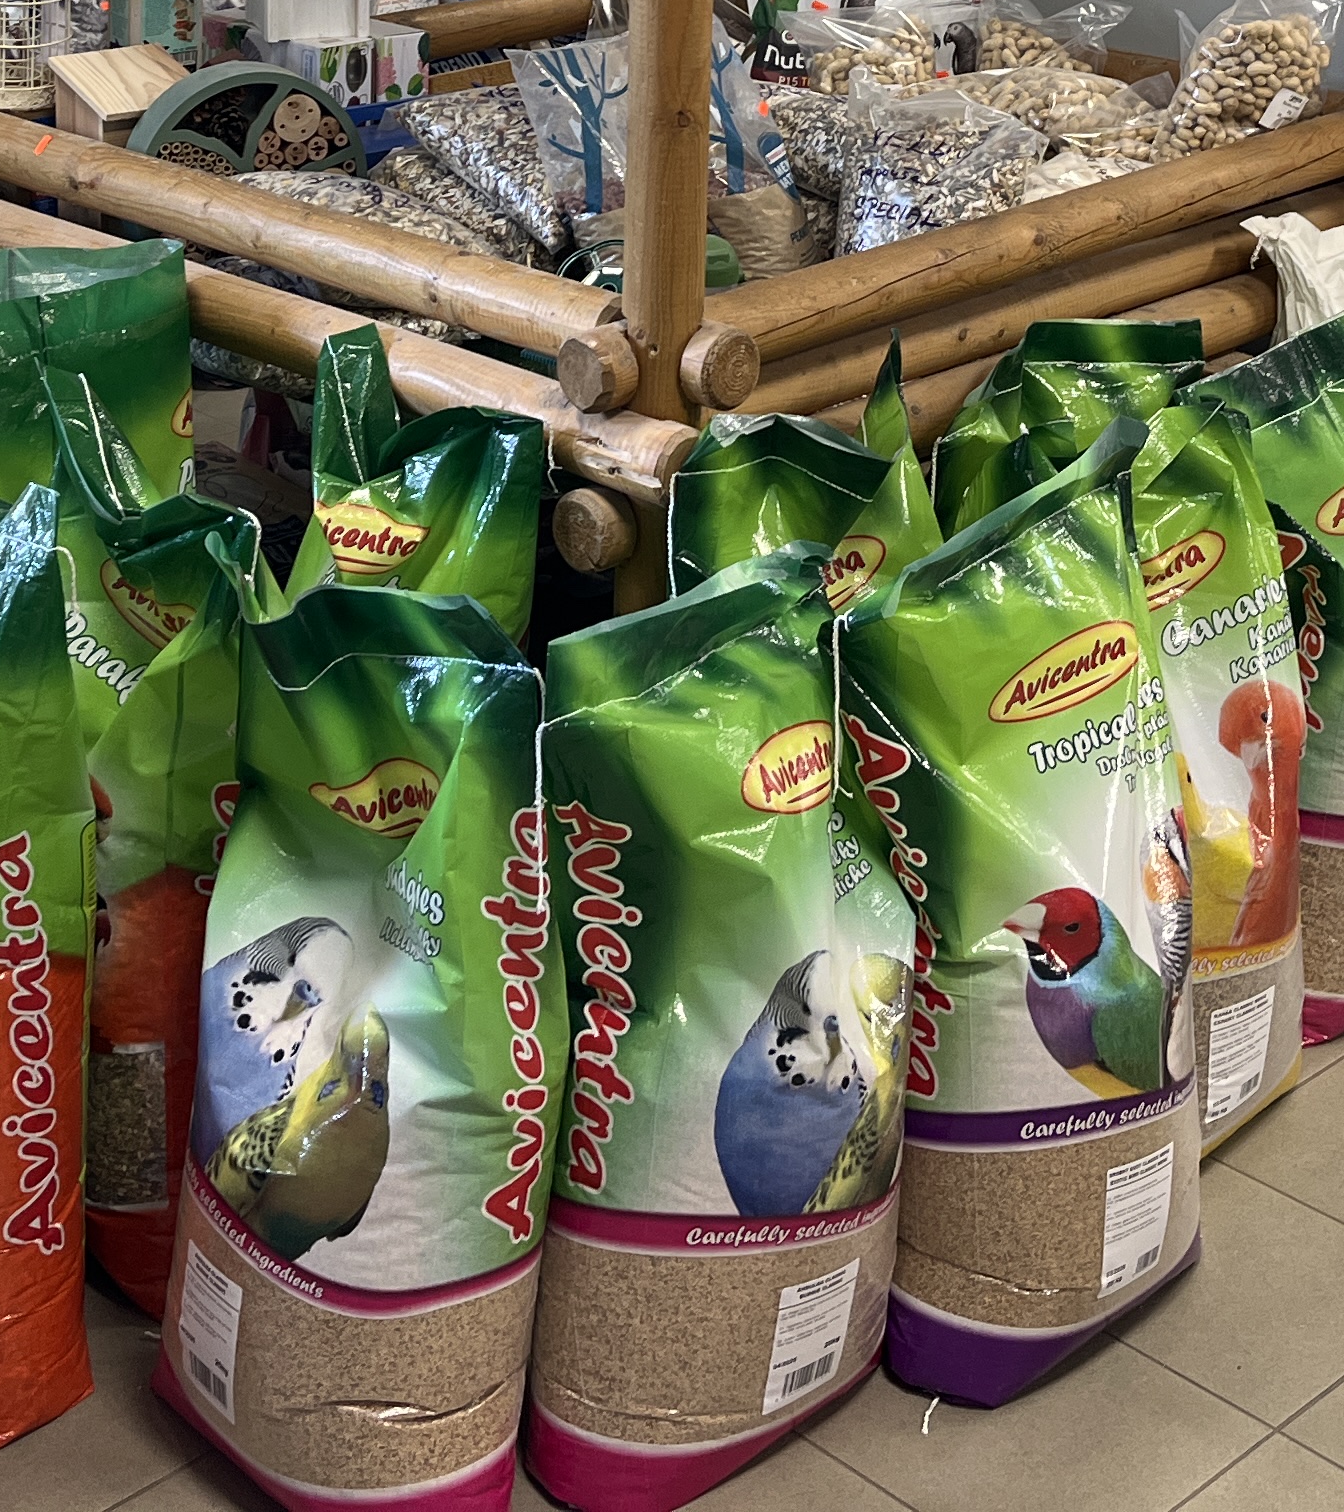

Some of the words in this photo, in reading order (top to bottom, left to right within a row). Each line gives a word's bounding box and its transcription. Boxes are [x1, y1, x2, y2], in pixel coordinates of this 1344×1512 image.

[1004, 636, 1127, 717] Avicentra
[1028, 702, 1136, 775] Tropical
[553, 800, 643, 1194] Avicentra
[1221, 948, 1276, 972] selected
[481, 805, 551, 1244] Avicentra
[1020, 1110, 1115, 1140] Carefully
[1119, 1095, 1173, 1125] selected
[199, 1186, 248, 1249] selected
[246, 1240, 325, 1300] ingredients
[685, 1223, 790, 1248] Carefully
[794, 1212, 860, 1242] selected
